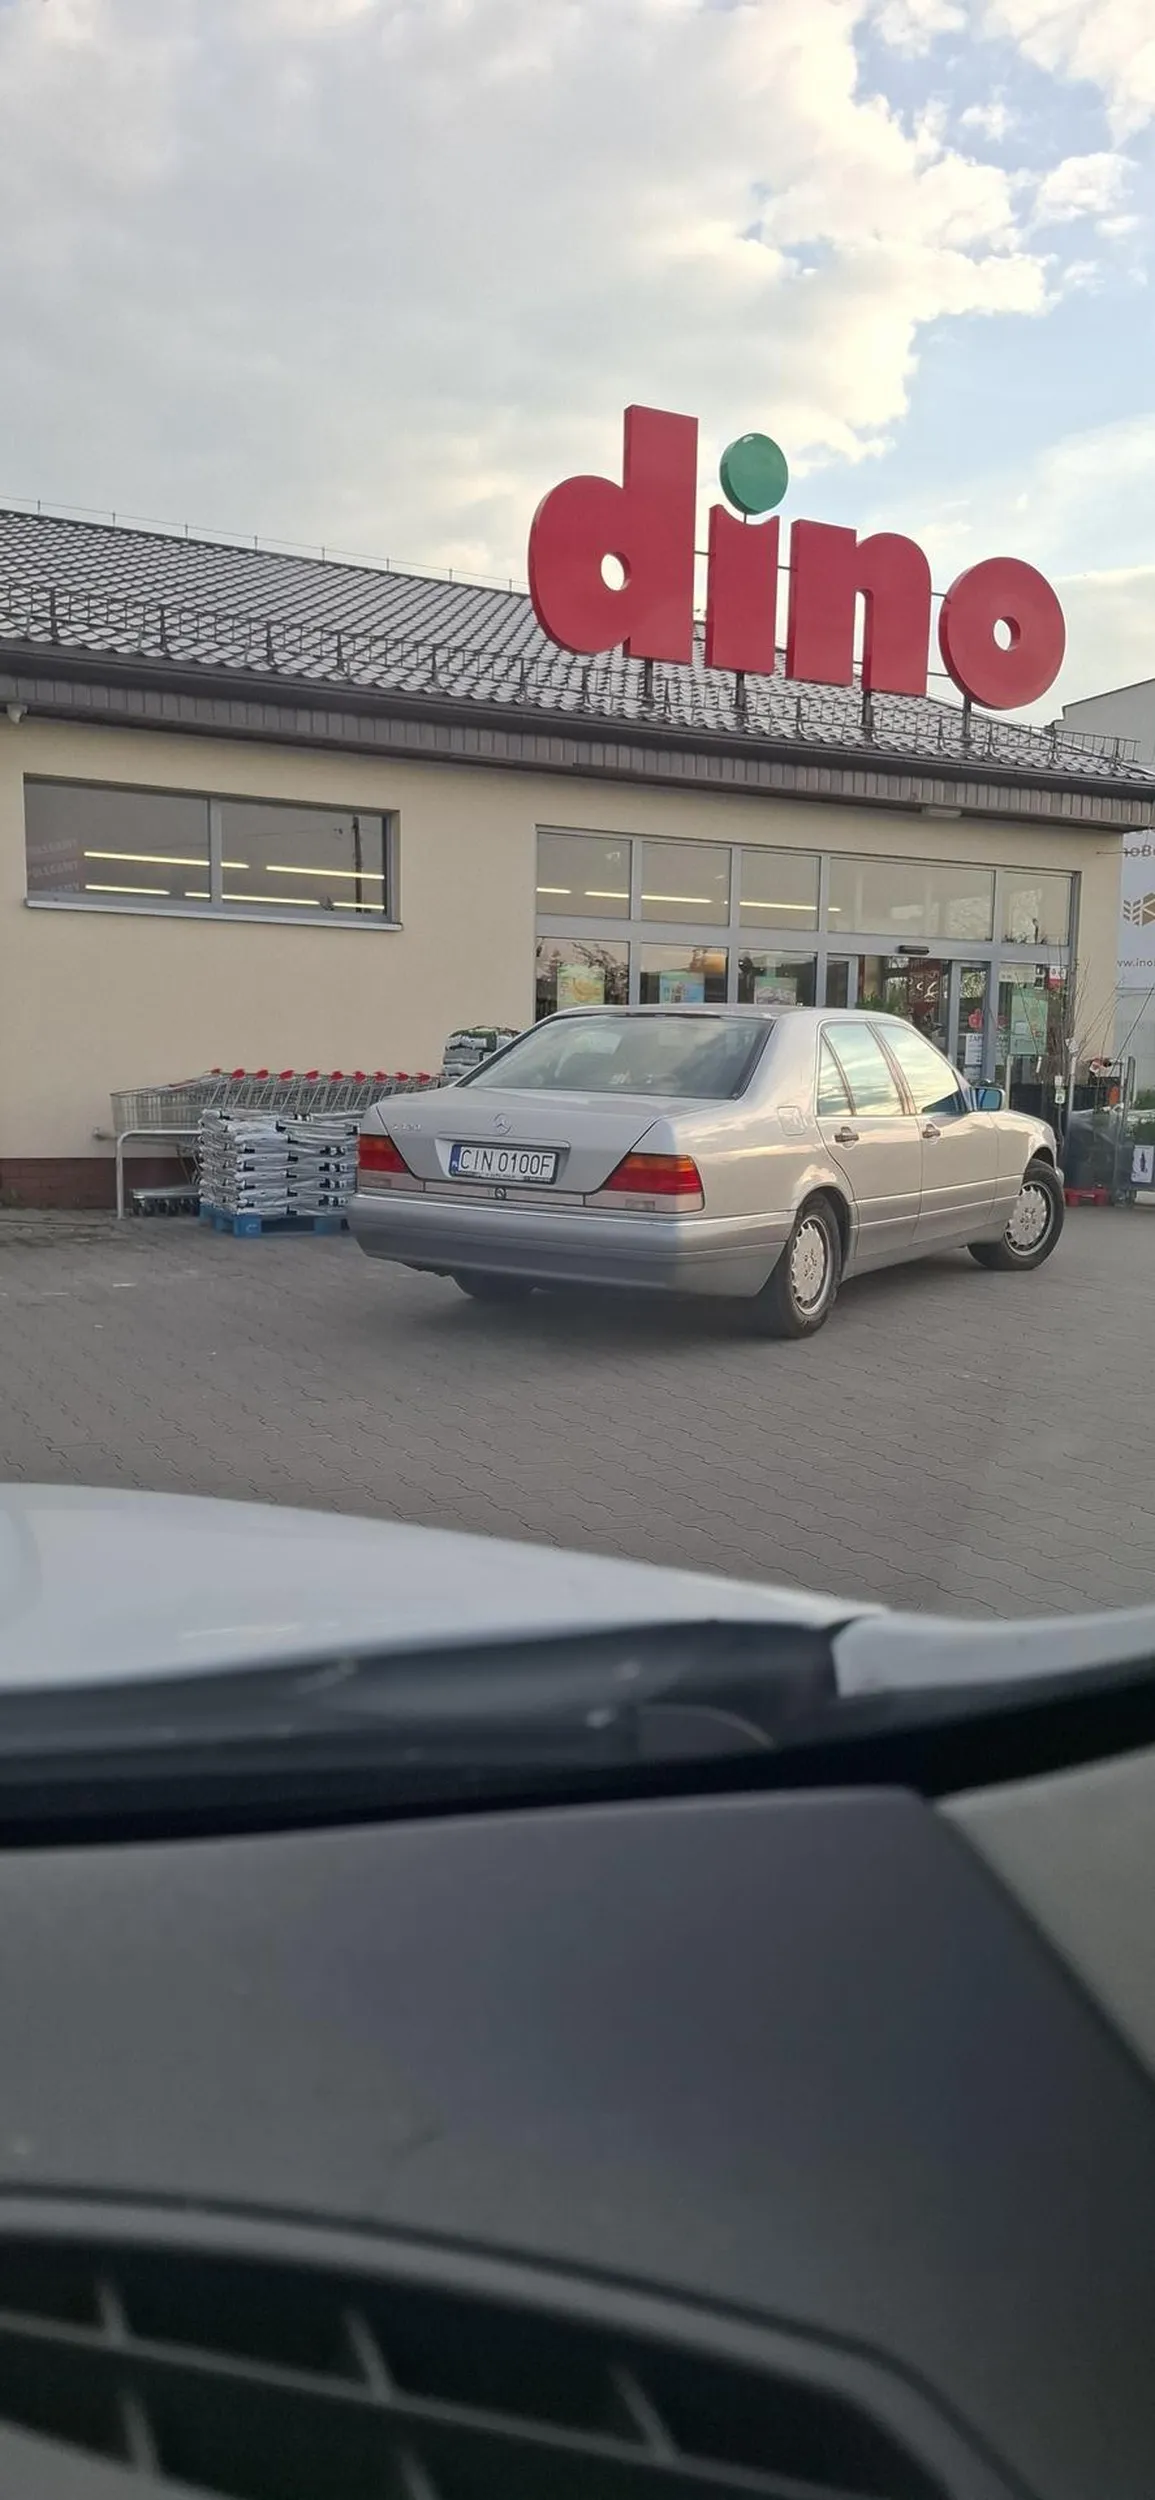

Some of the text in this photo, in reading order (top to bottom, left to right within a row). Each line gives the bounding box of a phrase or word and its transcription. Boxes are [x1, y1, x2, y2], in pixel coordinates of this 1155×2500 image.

[528, 404, 1066, 710] dino
[1124, 844, 1155, 857] oB
[461, 1149, 494, 1172] CIN
[498, 1152, 553, 1176] 0100F
